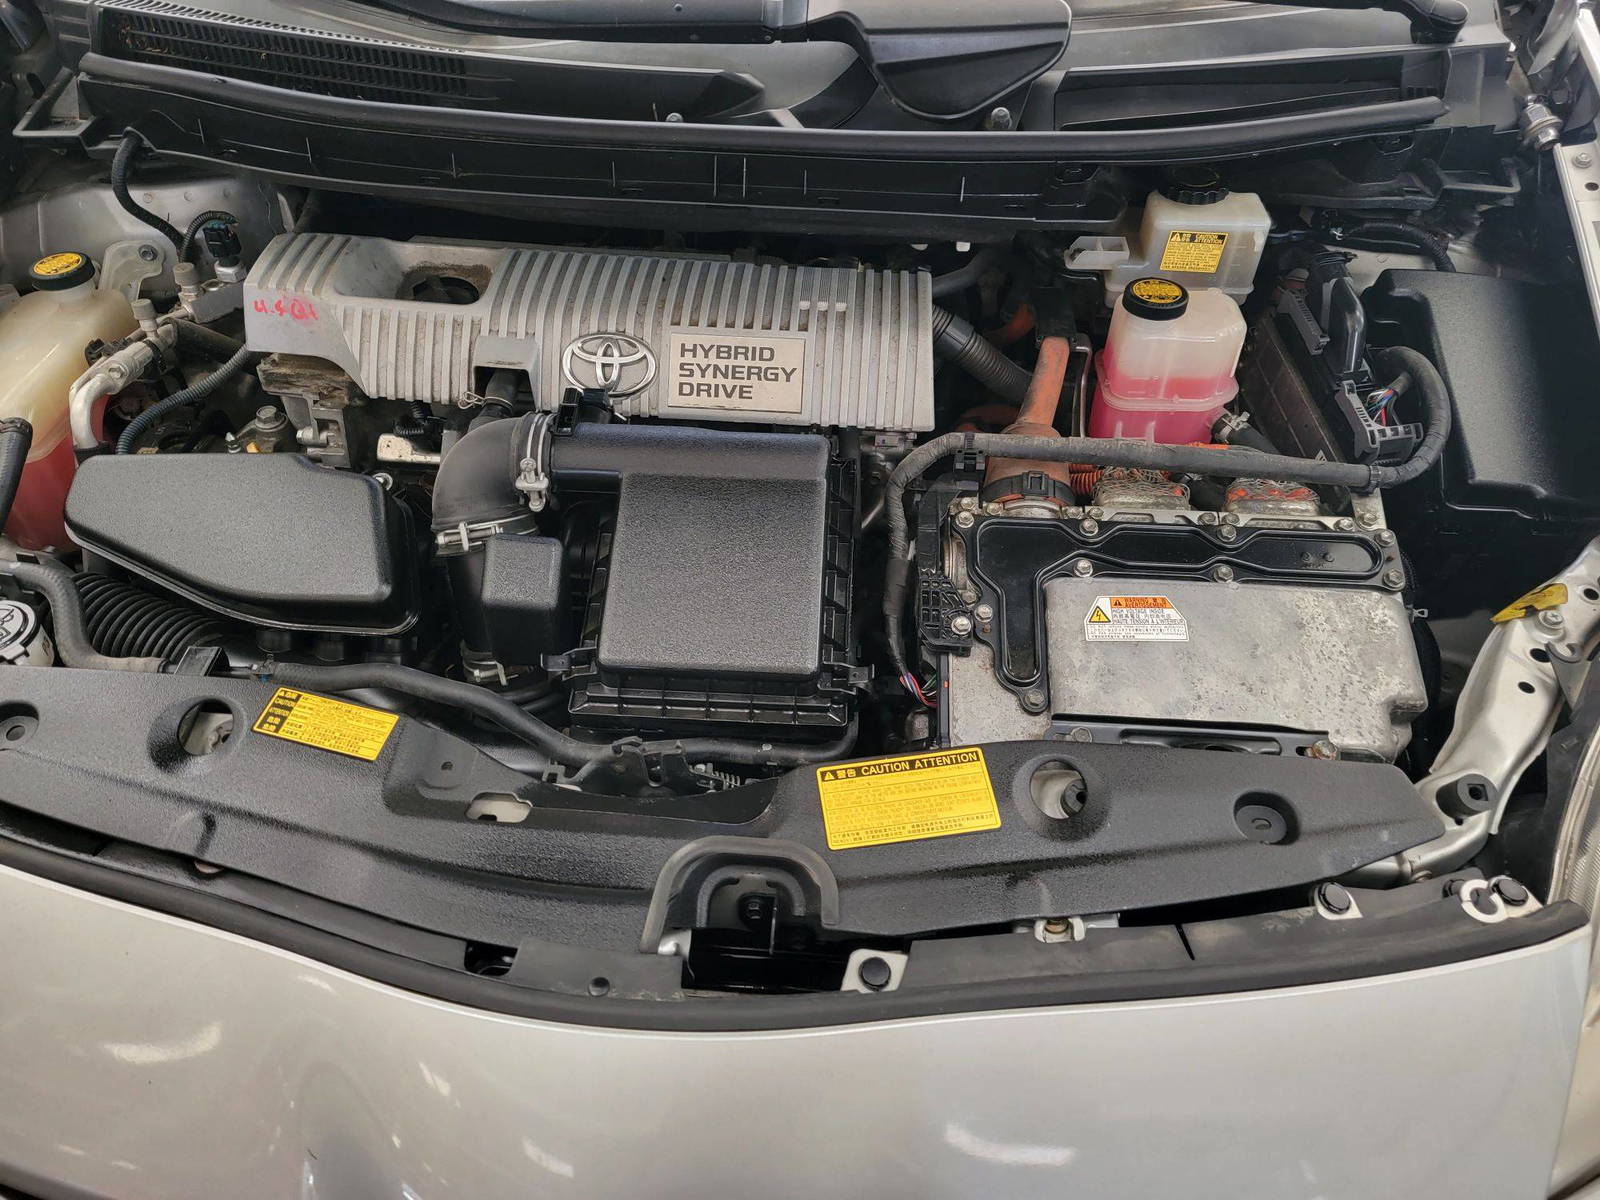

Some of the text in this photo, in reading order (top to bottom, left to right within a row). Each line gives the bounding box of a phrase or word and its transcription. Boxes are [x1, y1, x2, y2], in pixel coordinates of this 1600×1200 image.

[680, 343, 775, 361] HYBRID
[679, 362, 797, 382] SYNERGY
[678, 381, 753, 399] DRIVE
[861, 761, 910, 776] CAUTION
[915, 751, 978, 769] ATTENTION
